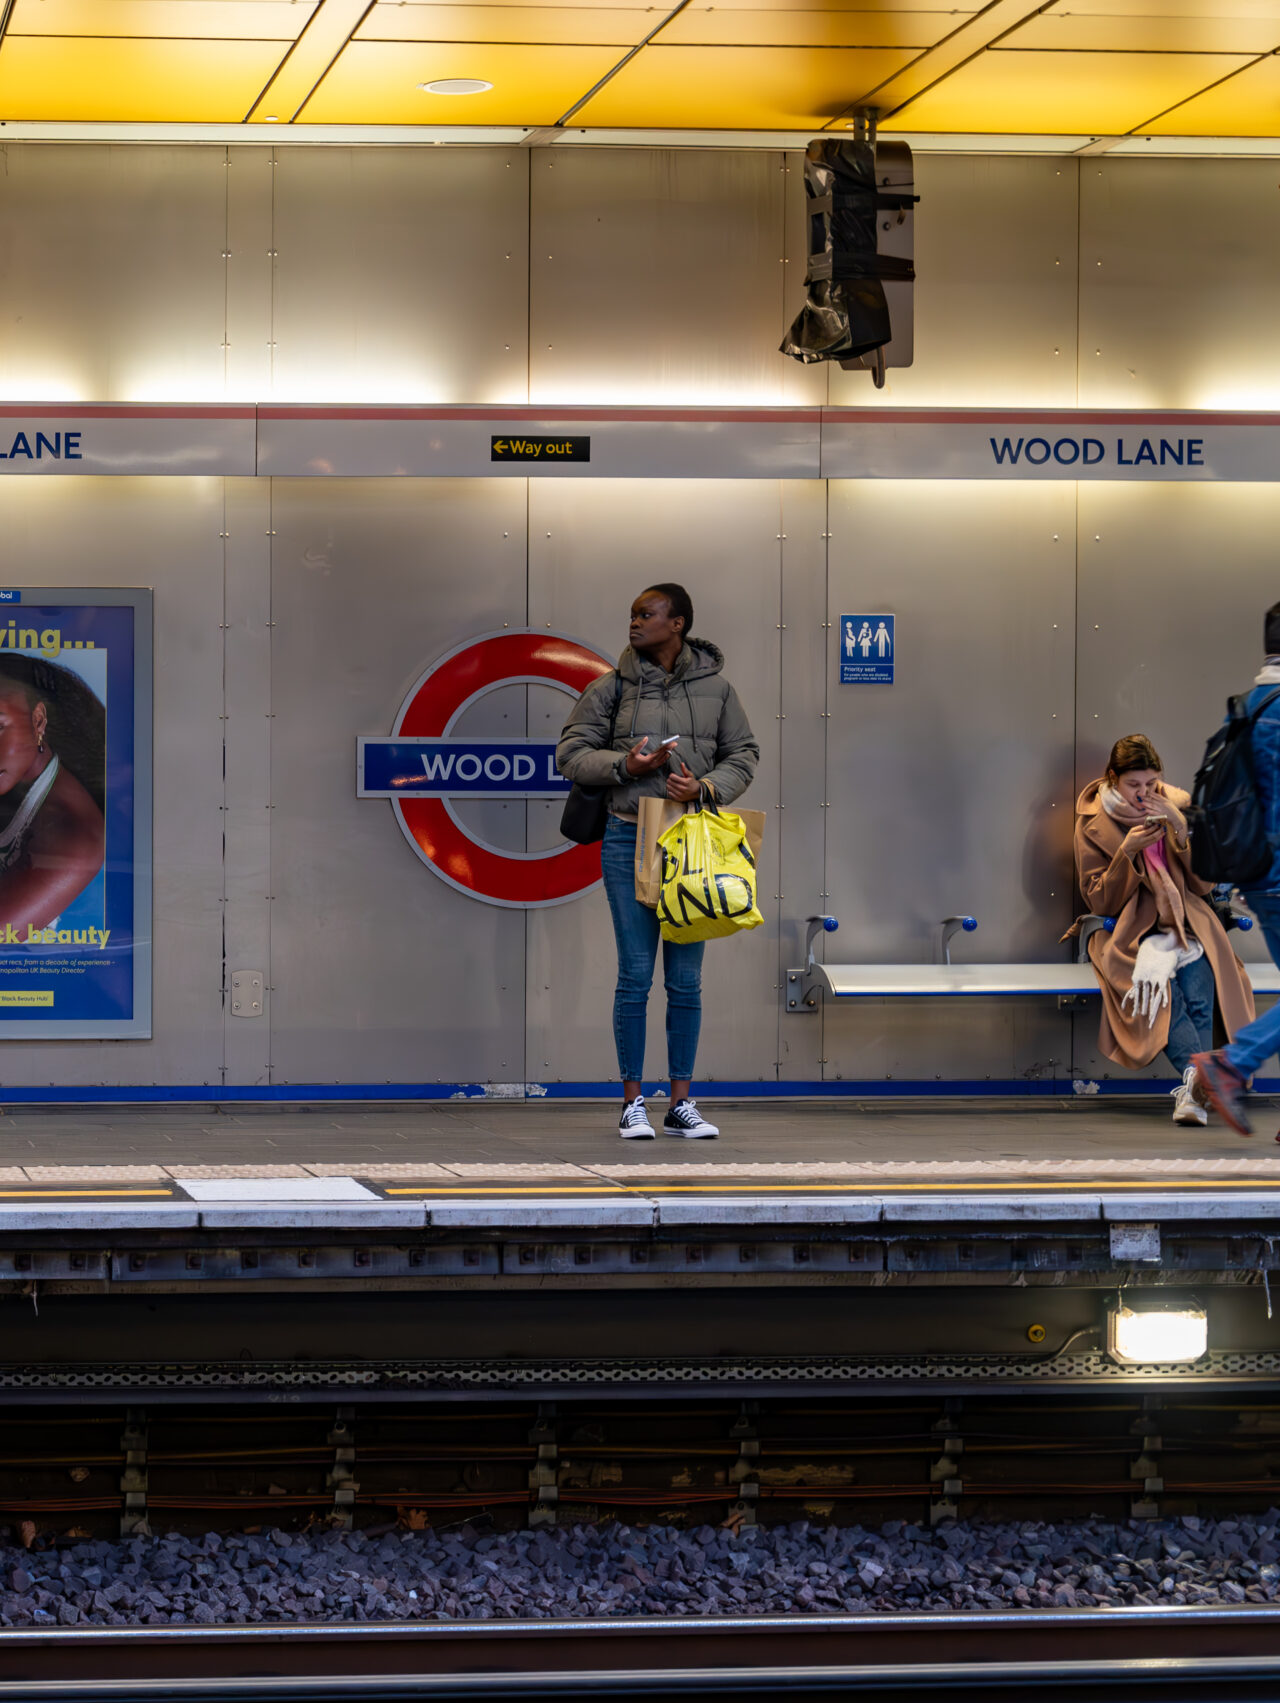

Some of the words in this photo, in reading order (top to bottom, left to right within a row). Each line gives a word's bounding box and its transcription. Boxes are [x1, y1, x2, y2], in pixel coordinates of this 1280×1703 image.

[509, 440, 542, 457] Way
[545, 441, 573, 454] out
[989, 437, 1105, 465] WOOD
[1117, 438, 1205, 465] LANE
[420, 753, 536, 781] WOOD
[547, 754, 569, 781] L
[28, 923, 111, 950] beauty
[23, 958, 39, 967] from
[29, 966, 39, 974] UK
[39, 966, 60, 975] Beauty
